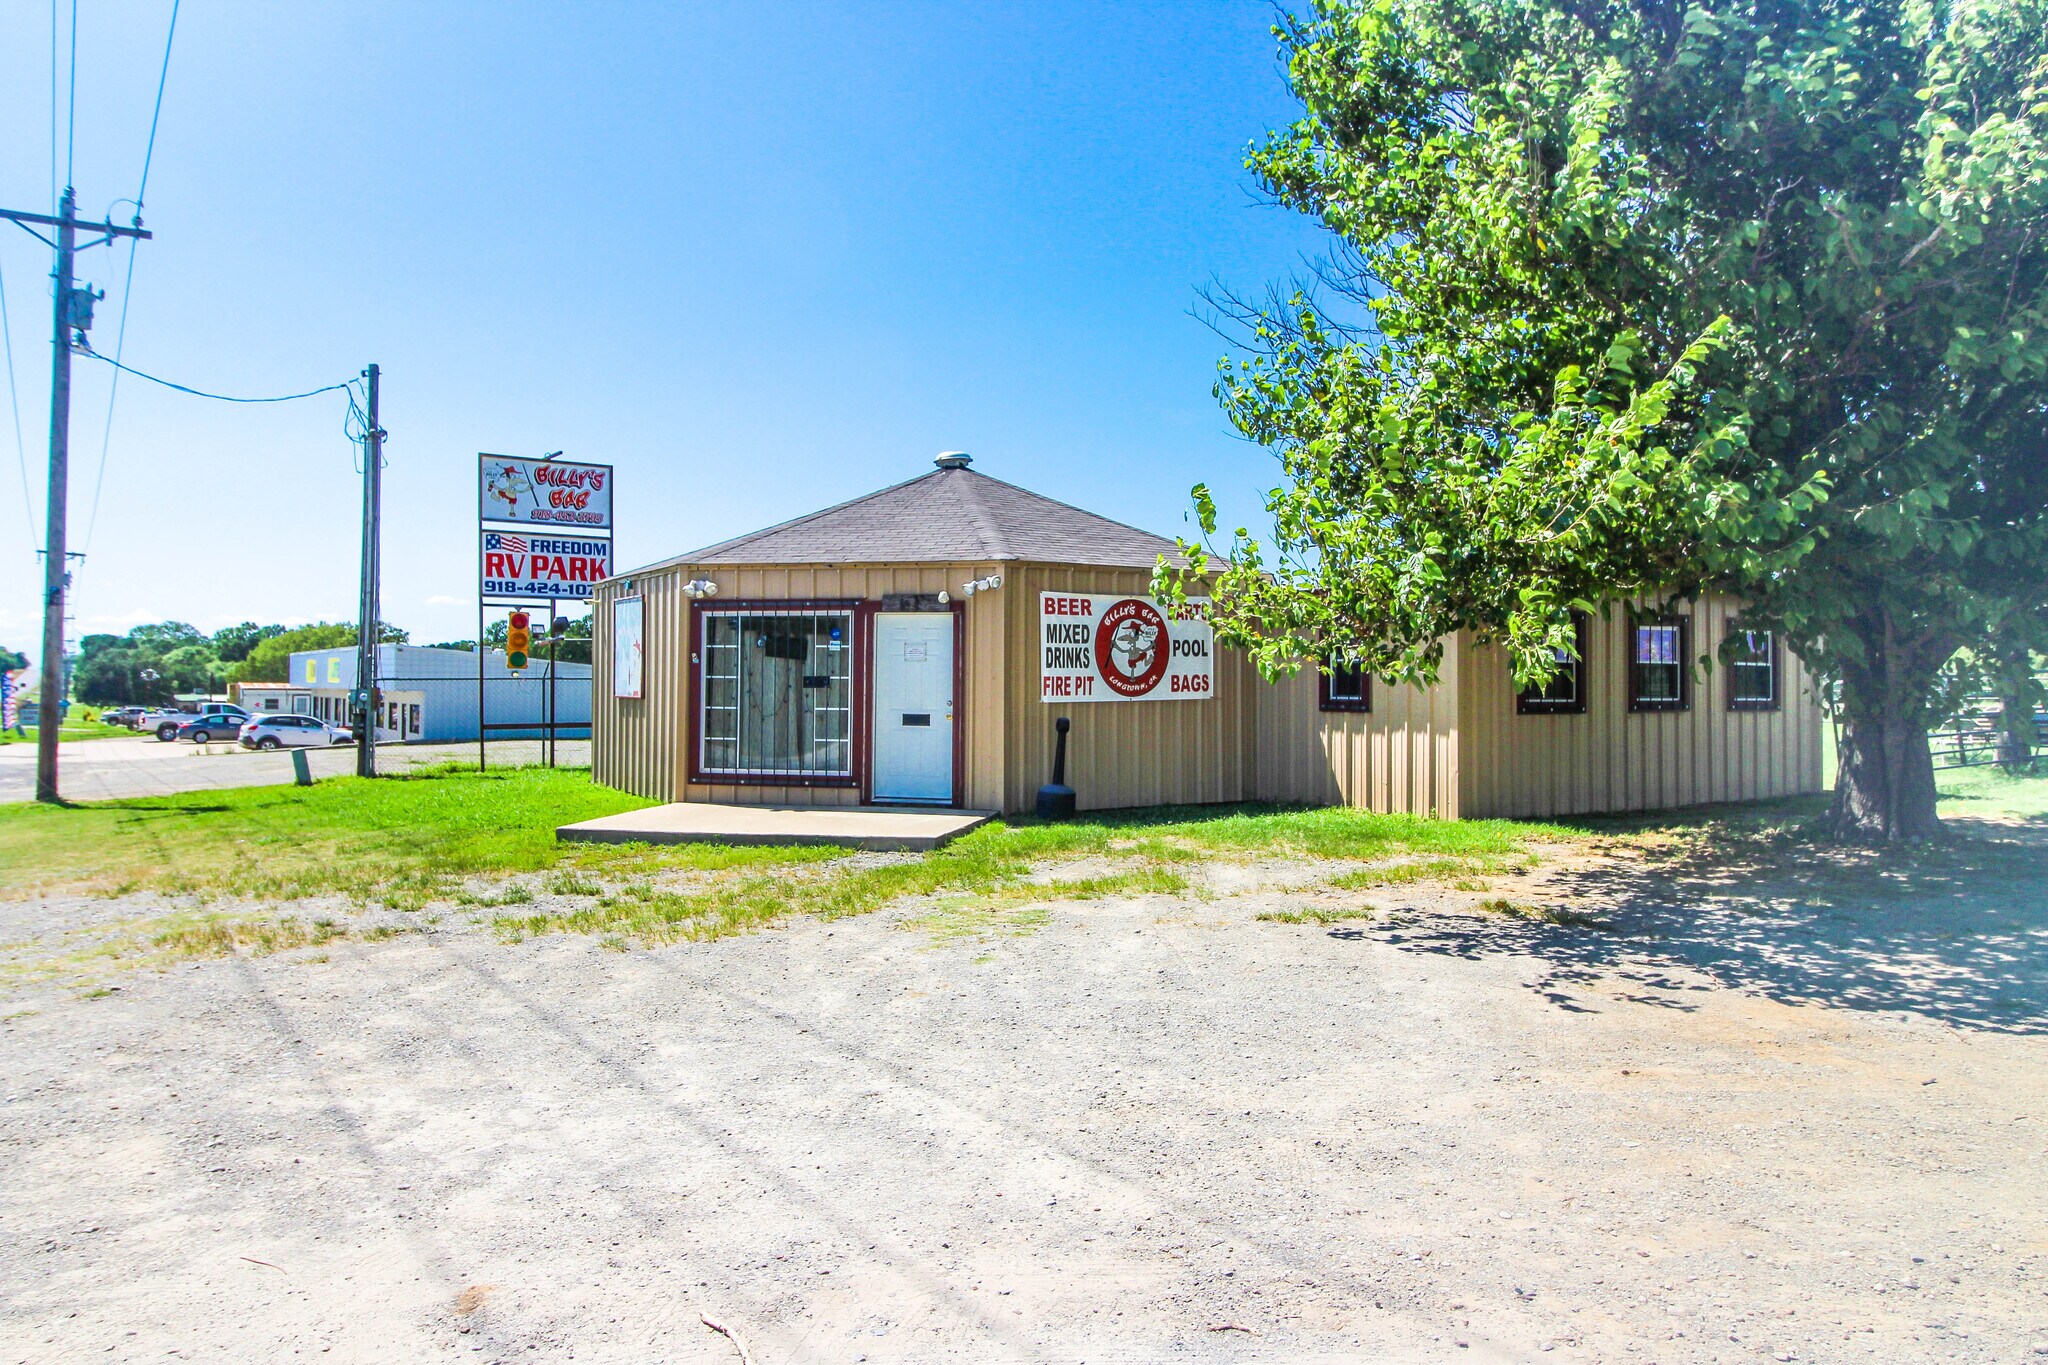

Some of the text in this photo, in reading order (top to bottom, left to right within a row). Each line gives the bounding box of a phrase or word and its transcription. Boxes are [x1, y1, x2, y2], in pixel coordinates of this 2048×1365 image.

[534, 464, 606, 491] BILLY'S
[549, 488, 591, 509] BAR
[530, 539, 607, 556] FREEDOM
[485, 553, 607, 582] RV PARK
[484, 580, 594, 596] 918-424-107
[1044, 597, 1093, 616] BEER
[1104, 603, 1160, 626] BILLY'S BAR
[1046, 623, 1090, 644] MIXED
[1046, 647, 1090, 669] DRINKS
[1173, 639, 1208, 657] POOL
[1043, 675, 1095, 697] FIRE PIT
[1148, 674, 1158, 685] OK
[1171, 674, 1210, 693] BAGS
